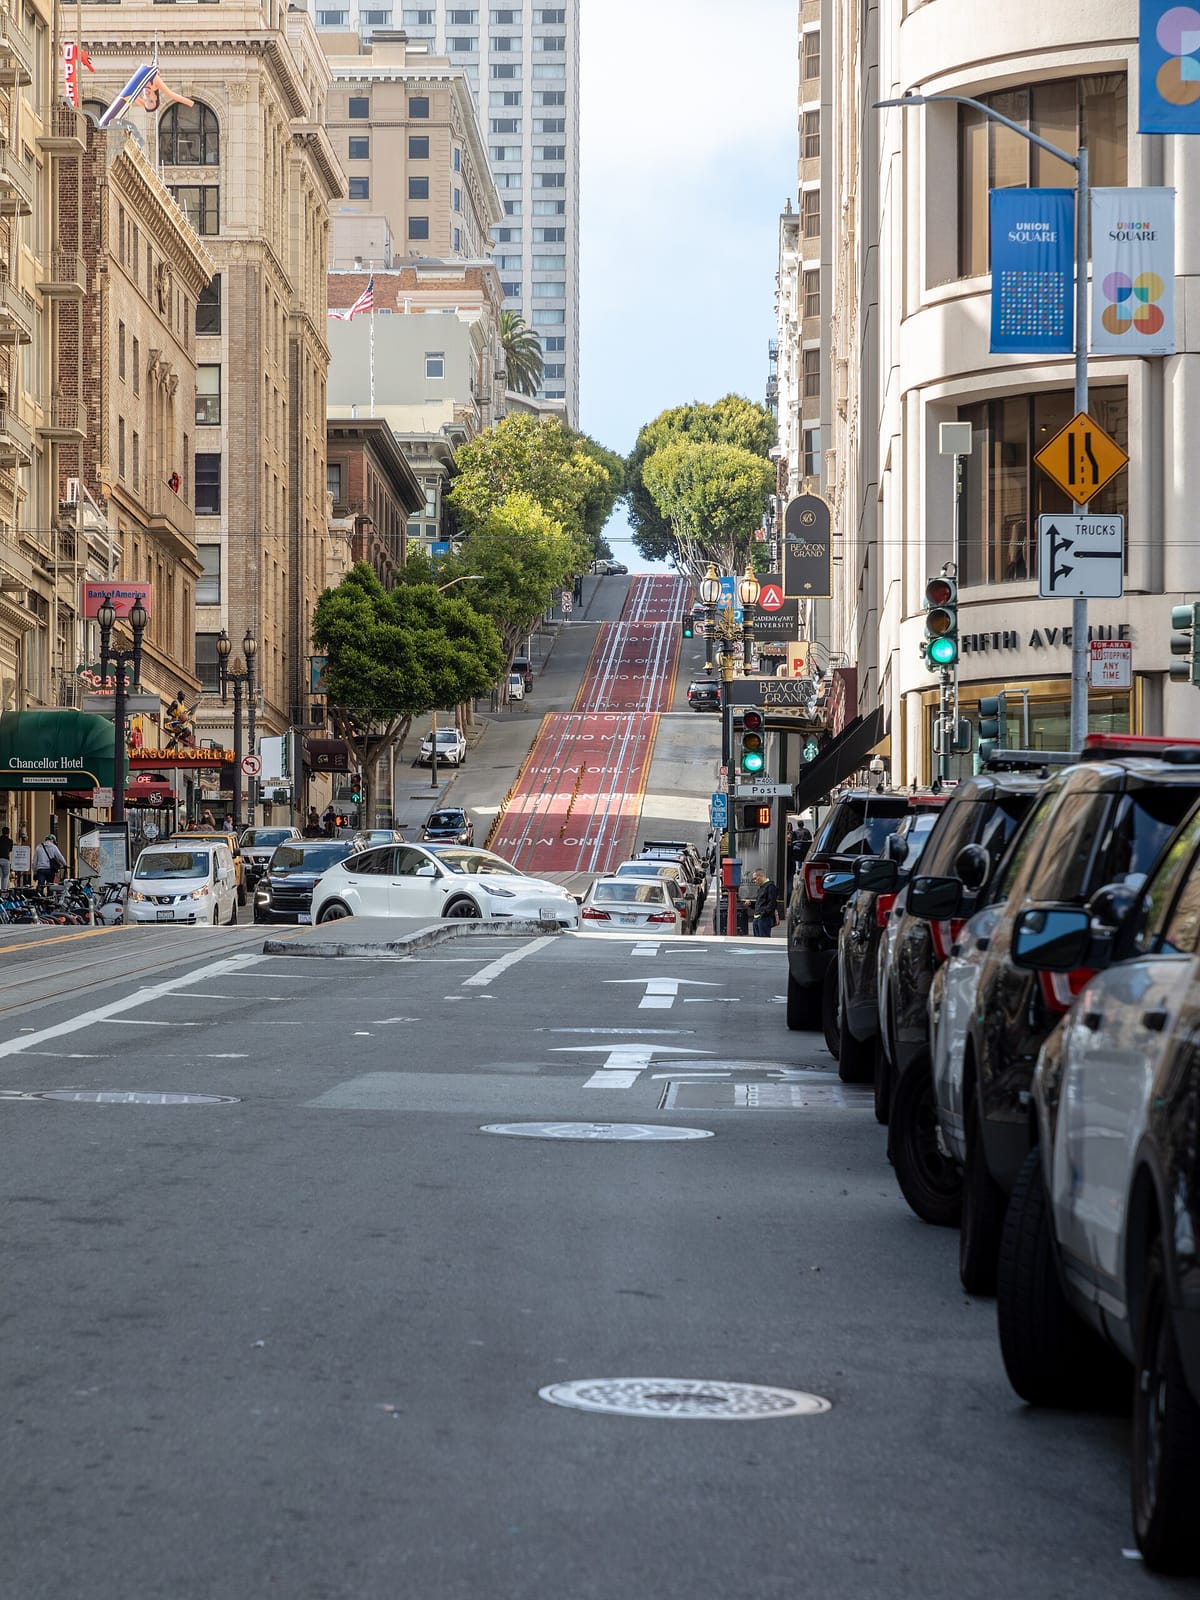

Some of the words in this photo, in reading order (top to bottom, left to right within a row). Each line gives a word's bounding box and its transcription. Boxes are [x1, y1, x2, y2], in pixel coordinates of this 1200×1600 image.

[64, 44, 75, 107] OPE
[1016, 222, 1050, 231] UNION
[1116, 222, 1150, 230] UNION
[1008, 231, 1058, 244] SQUARE
[1108, 230, 1159, 243] SQUARE
[1075, 524, 1116, 536] TRUCKS
[790, 543, 826, 552] BEACON
[793, 550, 823, 558] GRAND
[88, 590, 106, 598] Bank
[108, 590, 115, 598] of
[116, 590, 146, 598] America
[961, 630, 1017, 653] FIFTH
[1092, 649, 1102, 660] NO
[1103, 651, 1130, 660] STOPPING
[1103, 662, 1119, 670] ANY
[1102, 671, 1120, 680] TIME
[760, 681, 811, 694] BEACON
[765, 693, 808, 703] GRAND
[141, 748, 176, 759] ROOM
[178, 749, 187, 759] &
[189, 749, 222, 760] GRILL
[8, 757, 59, 769] Chancellor
[60, 756, 84, 769] Hotel
[752, 786, 777, 794] Post
[150, 792, 161, 801] 85
[760, 808, 769, 824] 10
